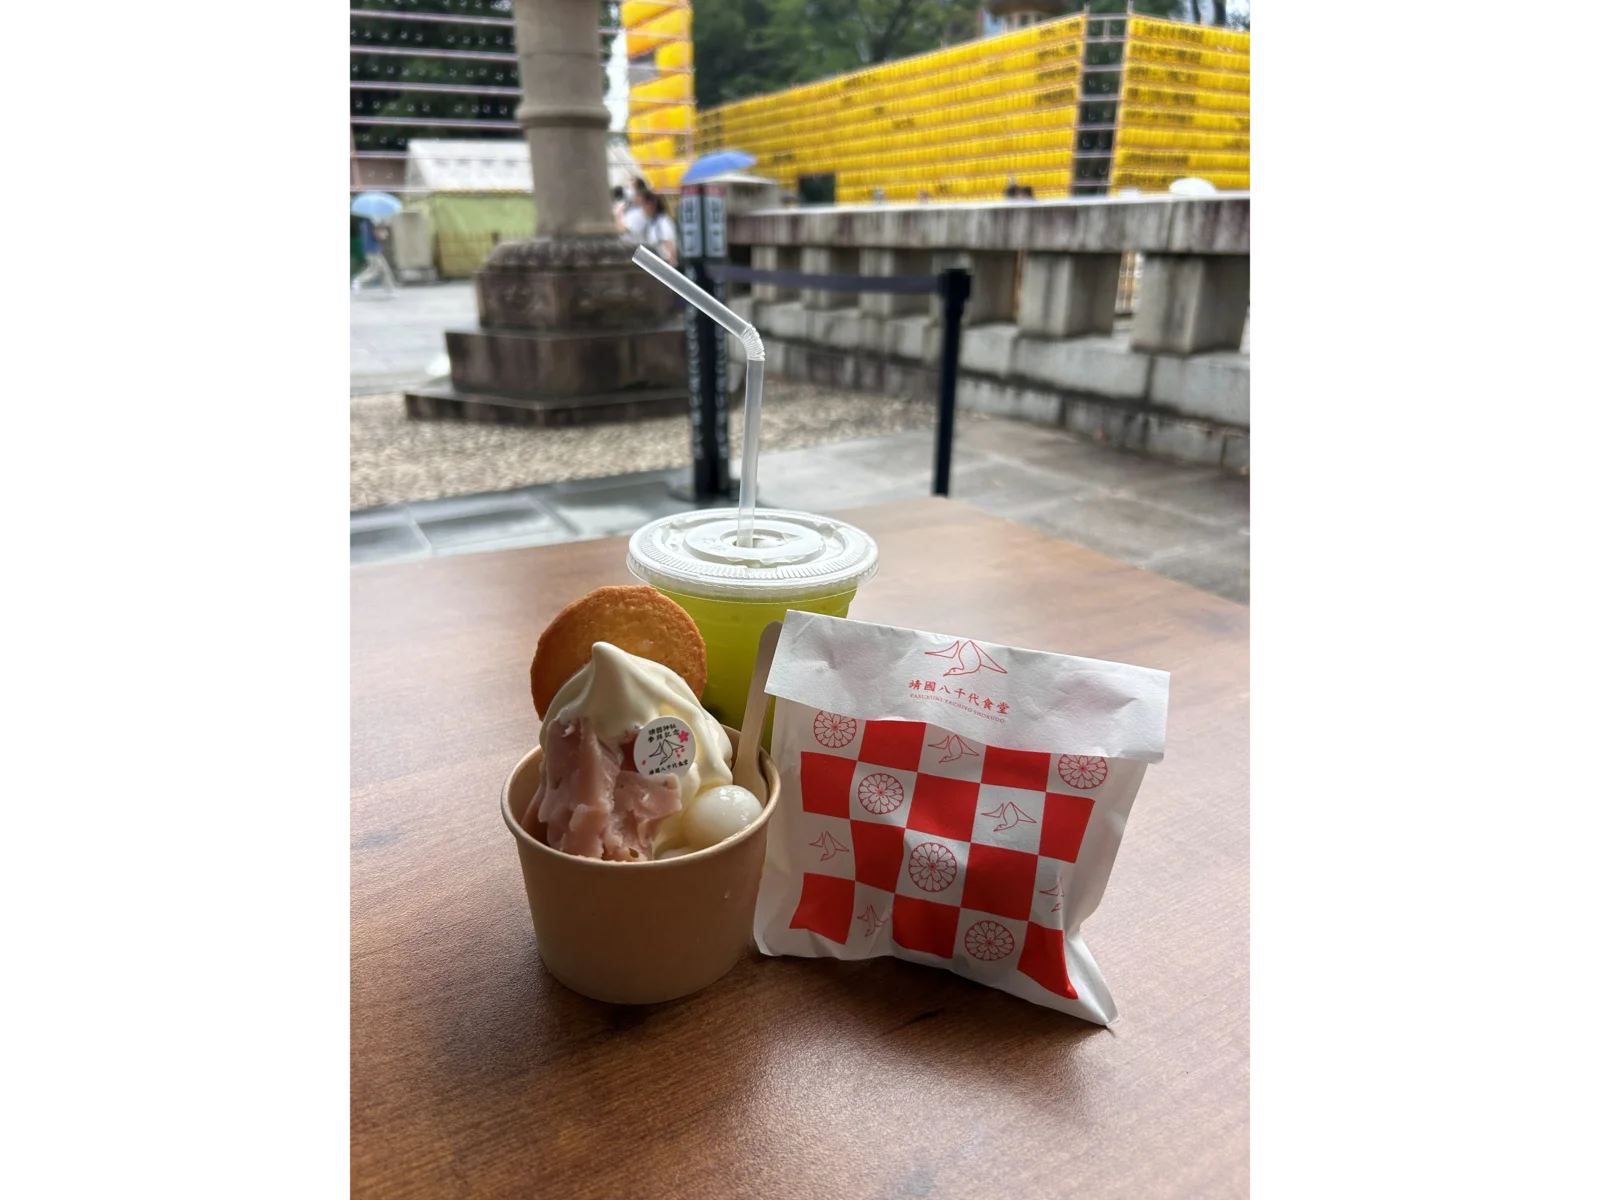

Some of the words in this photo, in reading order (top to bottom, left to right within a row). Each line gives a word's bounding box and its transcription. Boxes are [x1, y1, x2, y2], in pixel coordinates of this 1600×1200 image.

[908, 679, 1010, 715] 靖國八千代食堂
[910, 693, 943, 703] YASUKUNI
[945, 699, 973, 713] YACHIYO
[973, 710, 1005, 723] SHOKUDO
